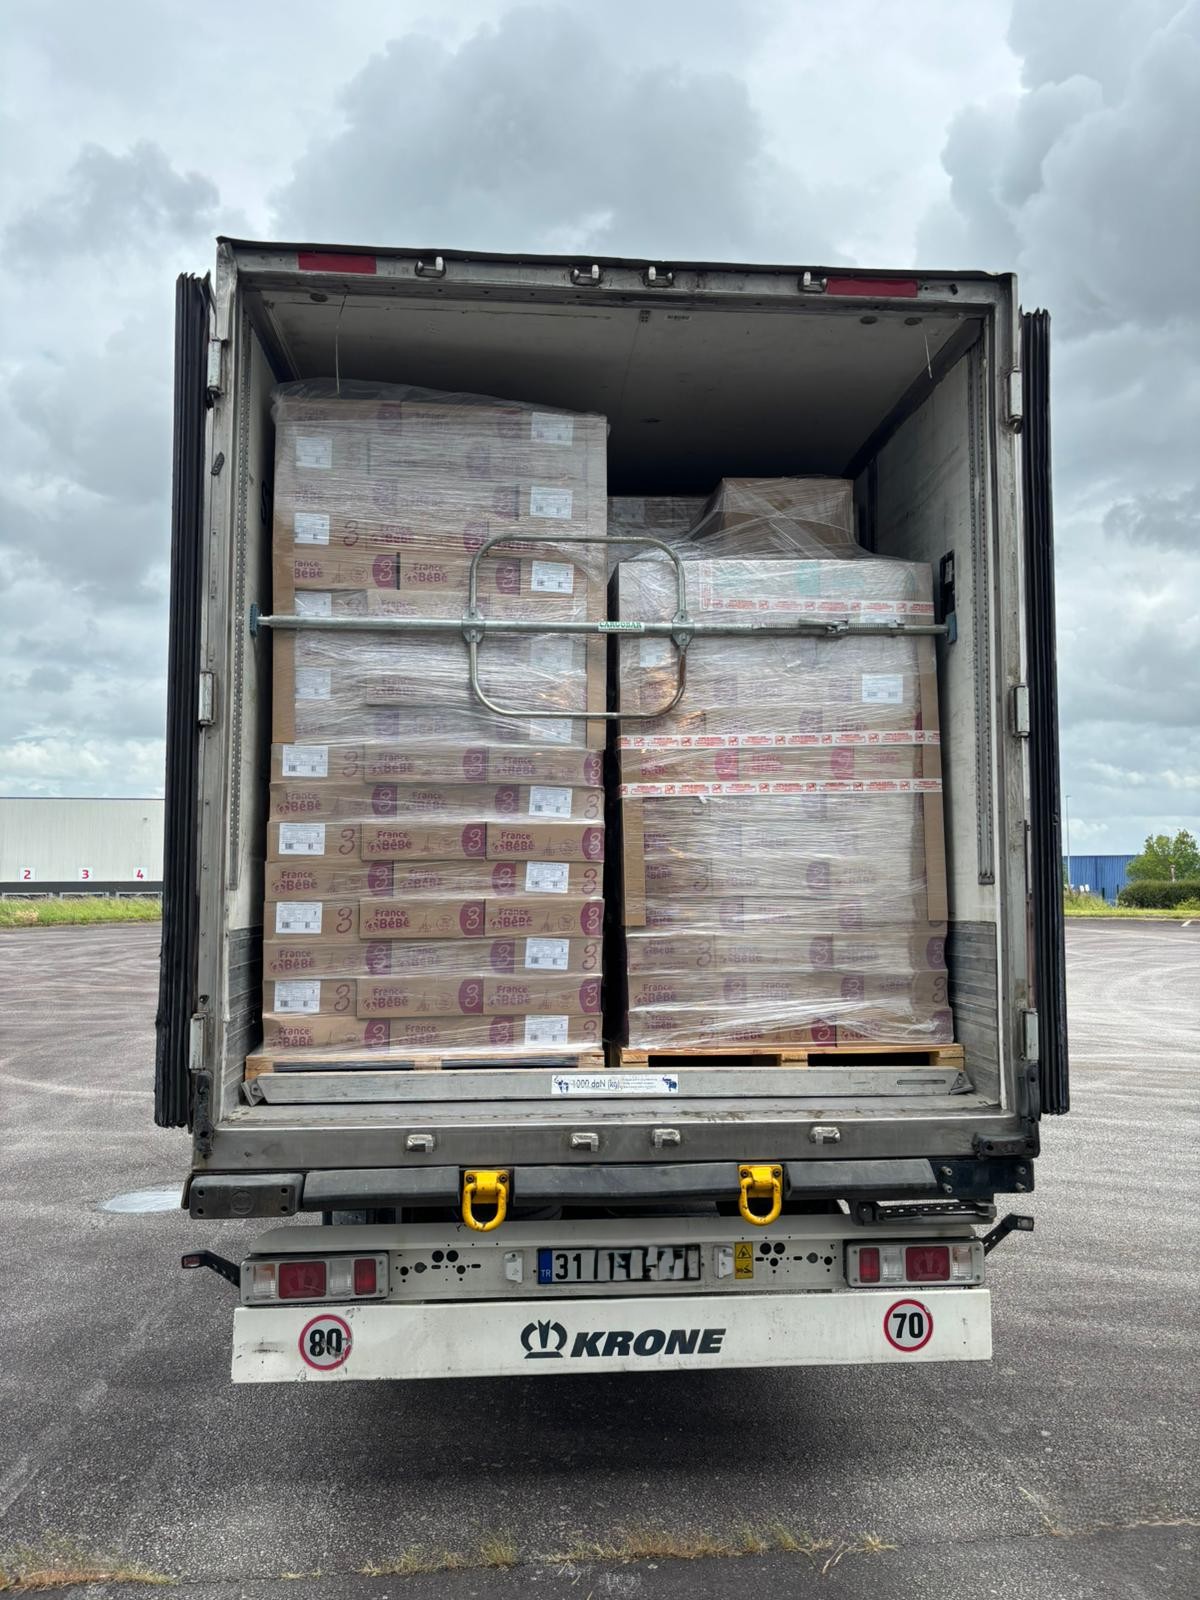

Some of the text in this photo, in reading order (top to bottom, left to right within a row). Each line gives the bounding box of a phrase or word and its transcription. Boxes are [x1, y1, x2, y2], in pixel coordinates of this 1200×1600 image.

[584, 794, 600, 819] 3
[338, 828, 356, 855] 3
[468, 829, 482, 850] 3
[588, 832, 601, 854] 3
[24, 870, 31, 880] 2
[82, 870, 89, 880] 3
[136, 870, 144, 880] 4
[336, 906, 352, 934] 3
[375, 909, 406, 917] France
[466, 906, 480, 929] 3
[586, 907, 600, 930] 3
[582, 944, 598, 970] 3
[334, 984, 350, 1012] 3
[464, 984, 479, 1007] 3
[541, 1270, 552, 1278] TR
[892, 1312, 924, 1338] 70
[310, 1328, 342, 1357] 80
[570, 1328, 726, 1358] KRONE
